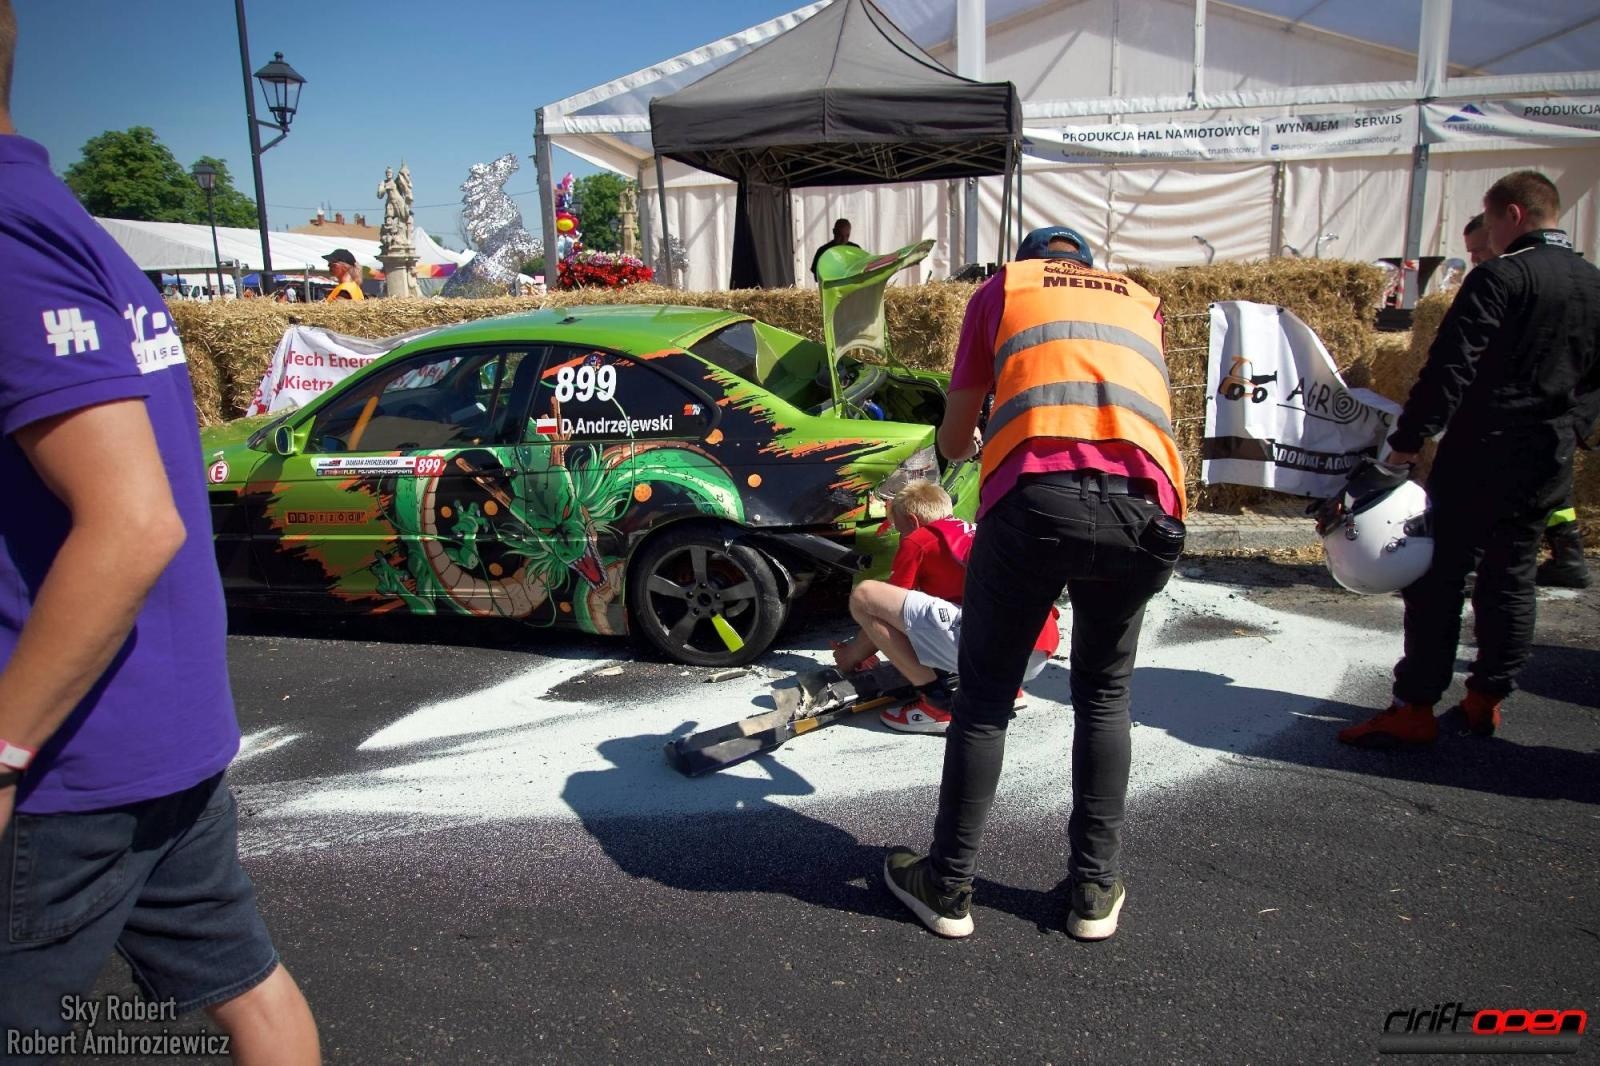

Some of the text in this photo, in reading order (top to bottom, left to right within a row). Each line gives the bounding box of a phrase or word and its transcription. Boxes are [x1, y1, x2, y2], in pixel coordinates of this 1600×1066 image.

[1524, 104, 1600, 116] PRODUKCJA
[1276, 114, 1403, 134] WYNAJEM SERWIS
[1062, 125, 1260, 142] PRODUKCJA HAL NAMIOTOWYCH
[1043, 276, 1130, 296] MEDIA
[286, 350, 323, 367] Tech
[555, 365, 617, 403] 899
[561, 415, 673, 437] D.Andrzejewski
[417, 458, 441, 474] 899
